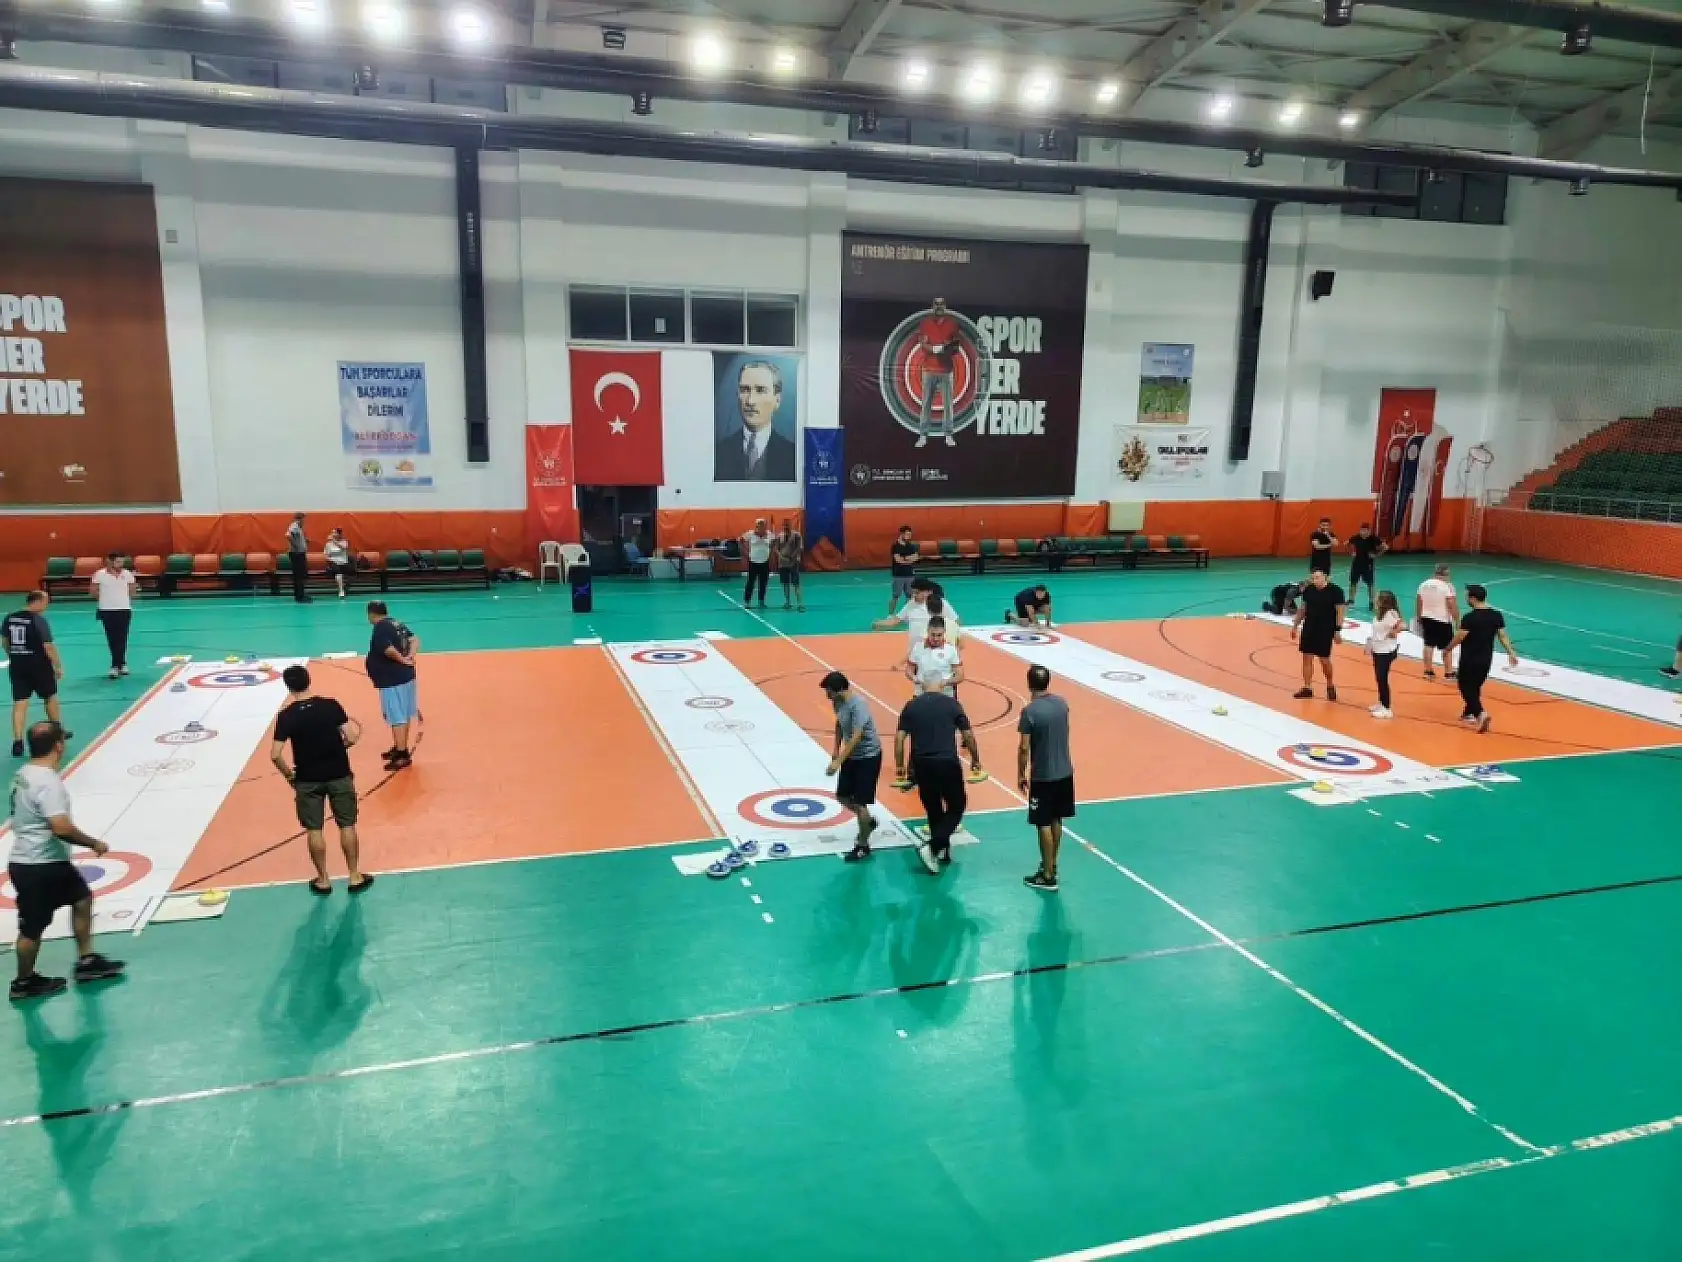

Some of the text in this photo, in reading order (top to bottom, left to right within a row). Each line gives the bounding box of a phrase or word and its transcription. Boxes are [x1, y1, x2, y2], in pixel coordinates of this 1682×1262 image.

[0, 293, 67, 332] POR
[976, 315, 1042, 353] SPOR
[0, 336, 46, 374] ER
[361, 366, 422, 380] SPORCULARA
[356, 385, 409, 399] BAŞARILAR
[367, 402, 404, 417] DİLERİM
[975, 399, 1046, 435] YERDE
[9, 625, 27, 645] 10
